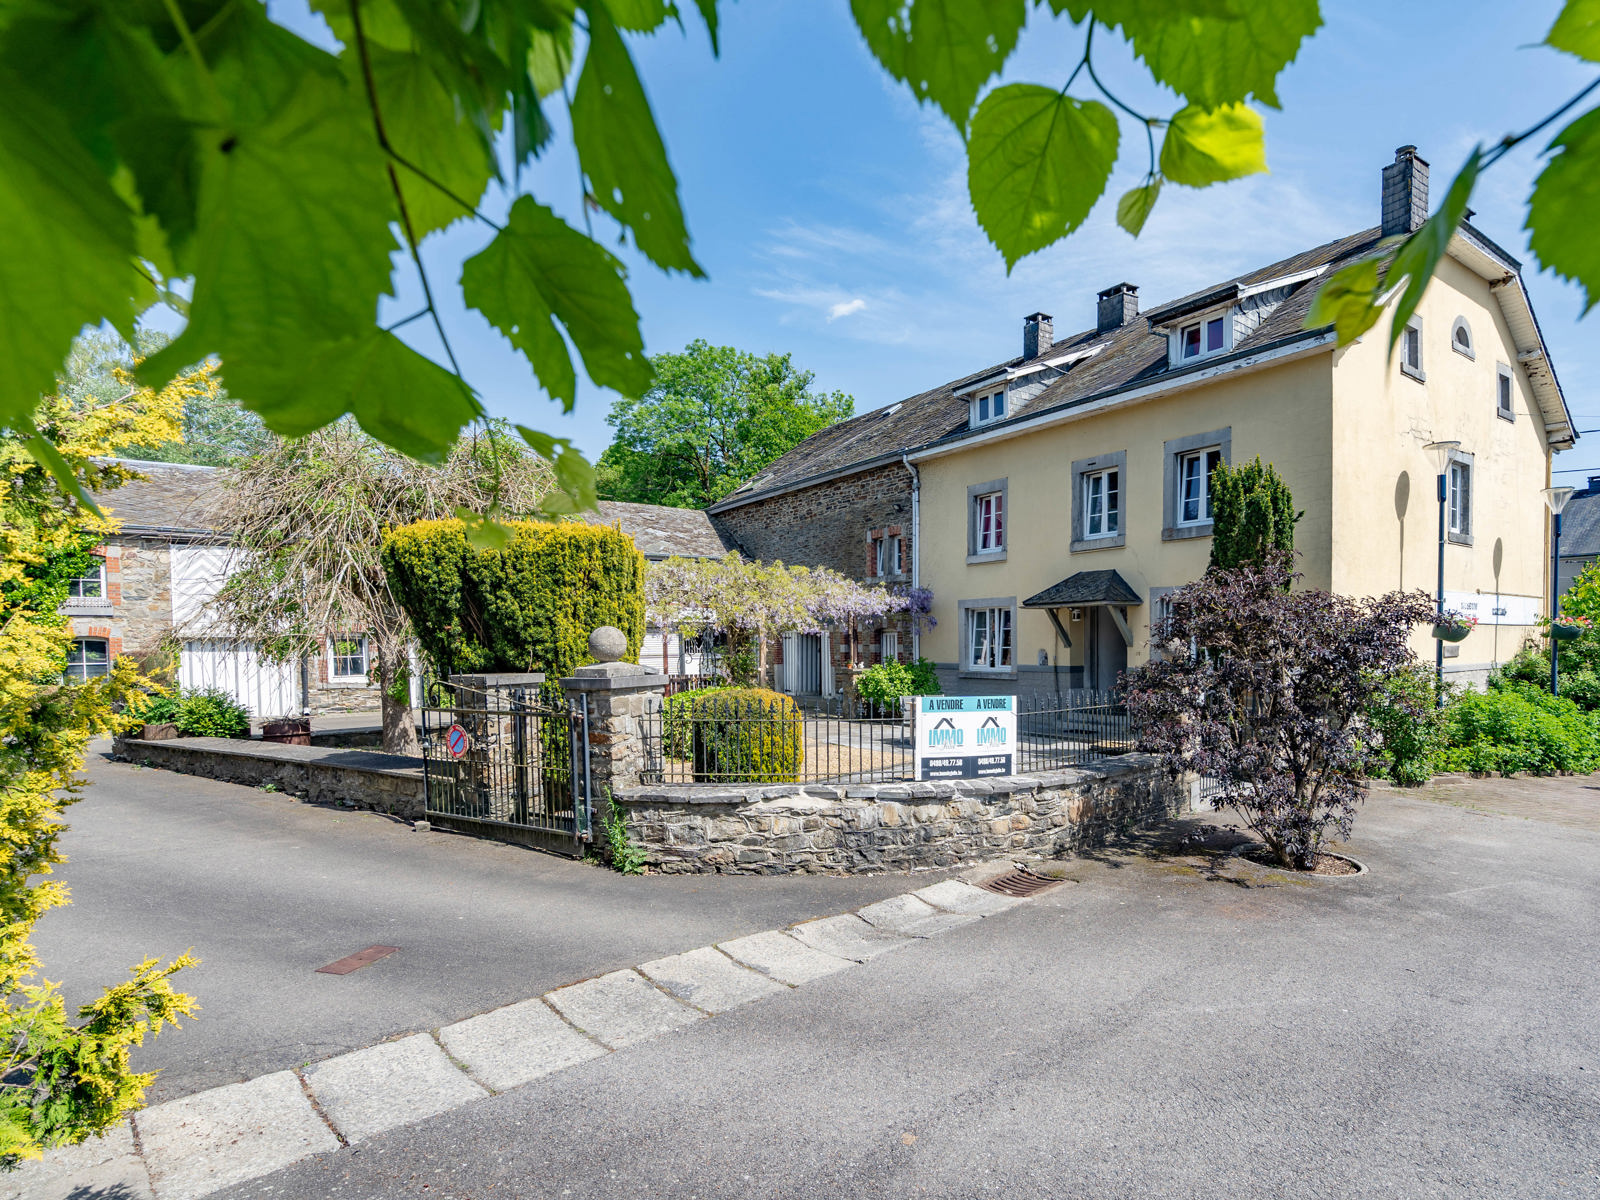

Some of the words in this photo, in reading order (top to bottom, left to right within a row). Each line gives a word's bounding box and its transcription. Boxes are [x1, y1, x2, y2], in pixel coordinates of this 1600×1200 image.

[929, 699, 935, 710] A
[936, 699, 964, 710] VENDRE
[976, 698, 982, 709] A
[983, 698, 1007, 709] VENDRE
[929, 728, 964, 746] IMMO
[976, 727, 1007, 744] IMMO
